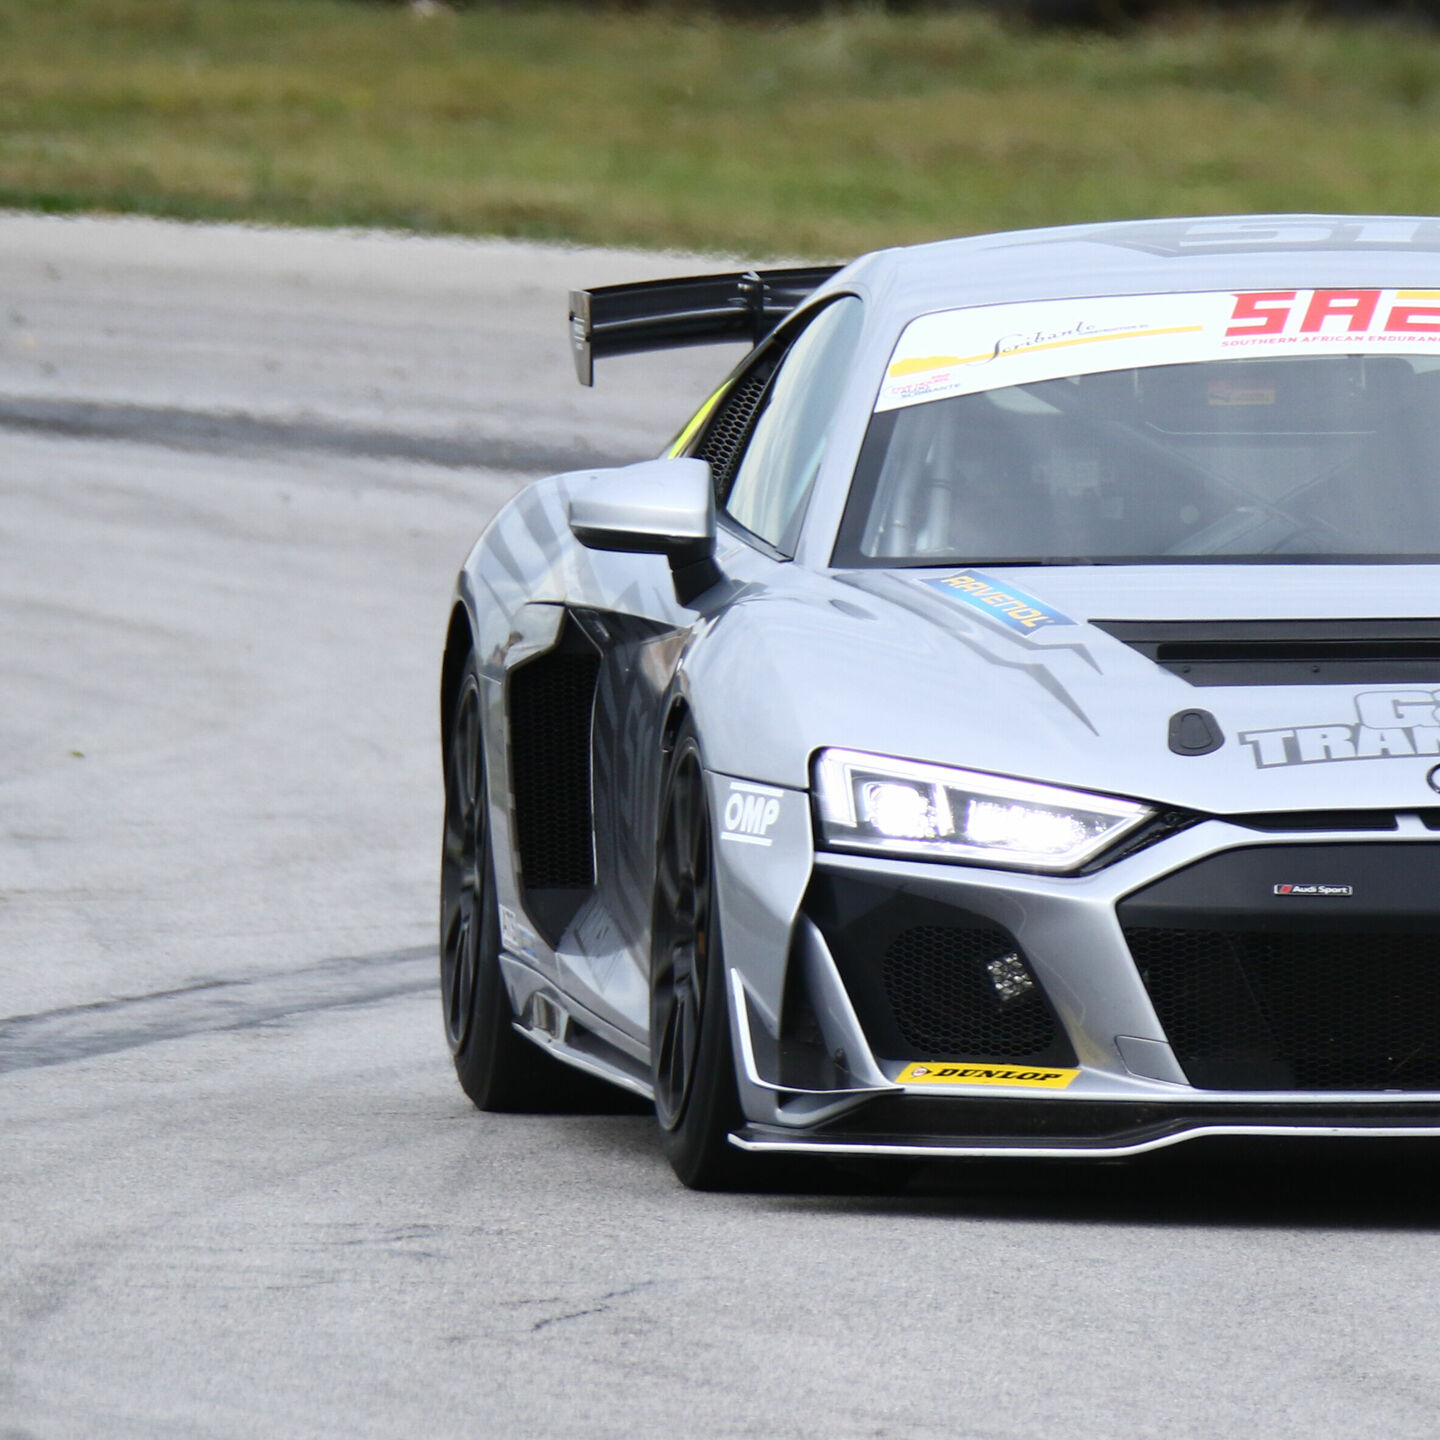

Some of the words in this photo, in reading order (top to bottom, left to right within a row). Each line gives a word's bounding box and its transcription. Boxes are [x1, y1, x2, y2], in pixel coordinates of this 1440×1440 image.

[1221, 337, 1297, 347] SOUTHERN
[1302, 335, 1364, 344] AFRICAN
[941, 575, 1051, 628] RAVENOL
[724, 792, 780, 835] OMP
[1292, 885, 1317, 893] Audi
[1318, 885, 1348, 894] Sport
[934, 1068, 1063, 1082] DUNLOP
